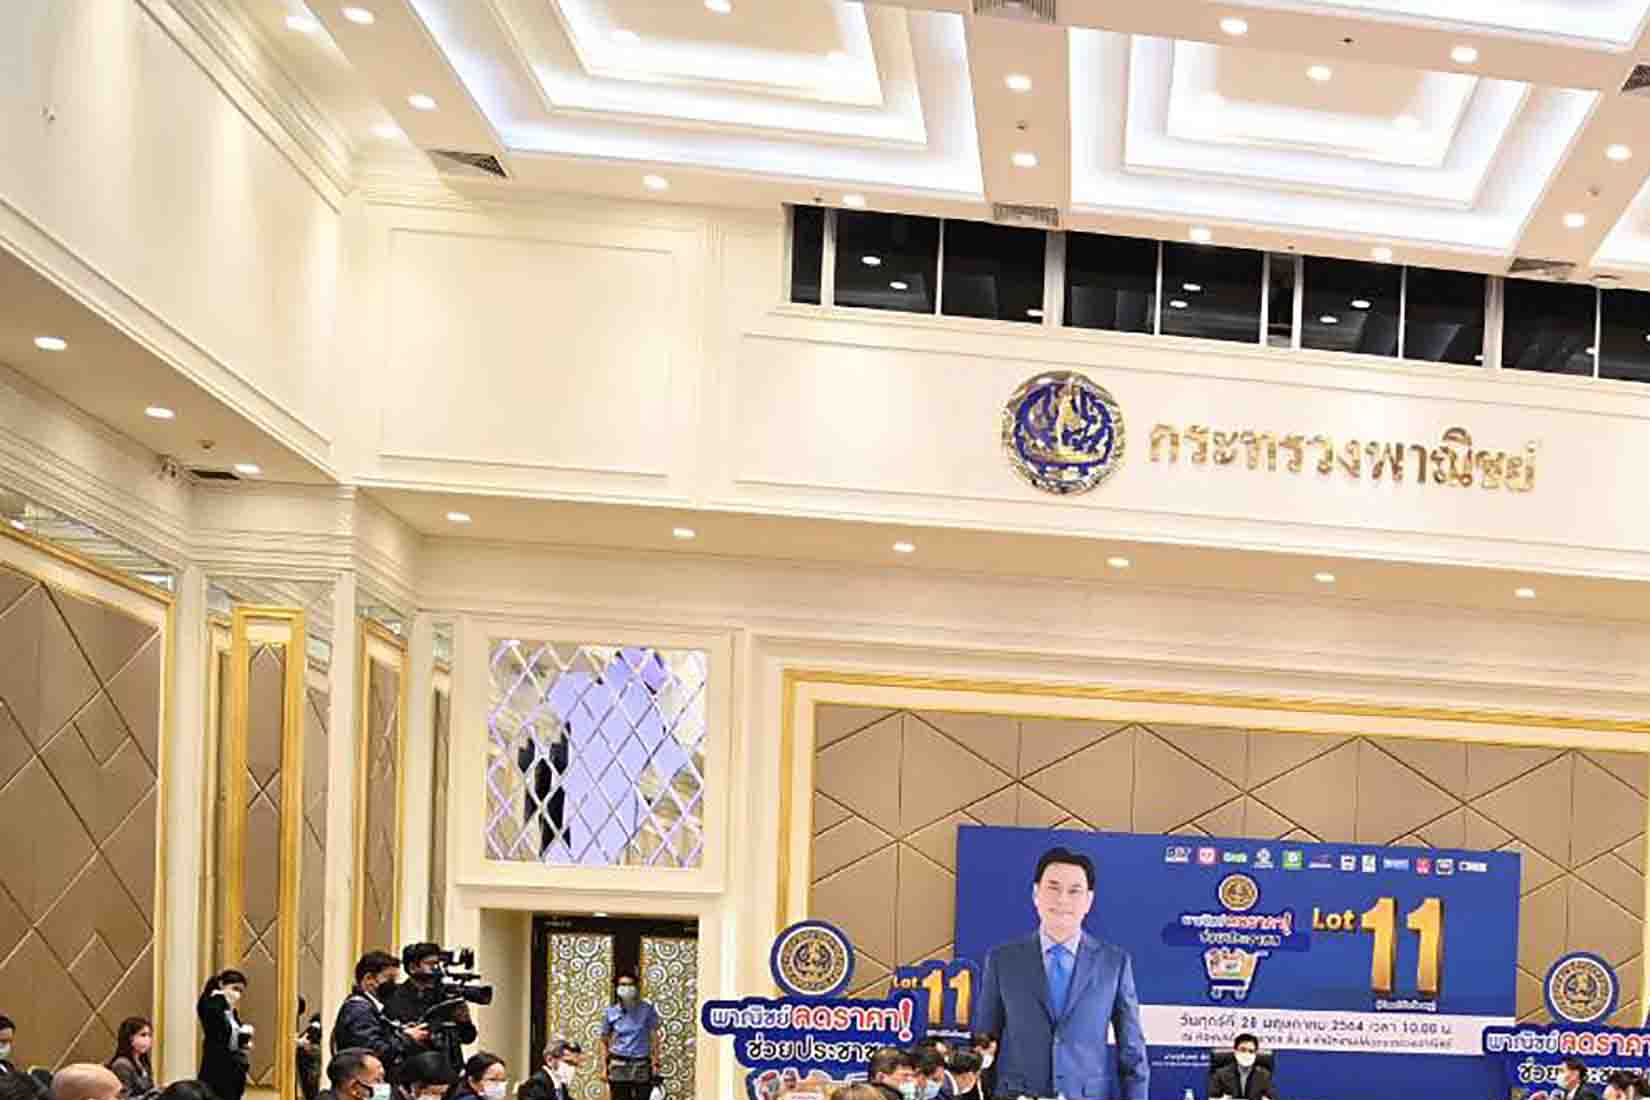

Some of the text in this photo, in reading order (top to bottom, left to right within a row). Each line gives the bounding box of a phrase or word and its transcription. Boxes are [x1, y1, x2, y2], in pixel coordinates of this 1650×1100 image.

[1148, 423, 1537, 493] กระทรวงพาณิชย์
[1313, 896, 1442, 994] Lot 11
[893, 968, 971, 1025] Lot 11
